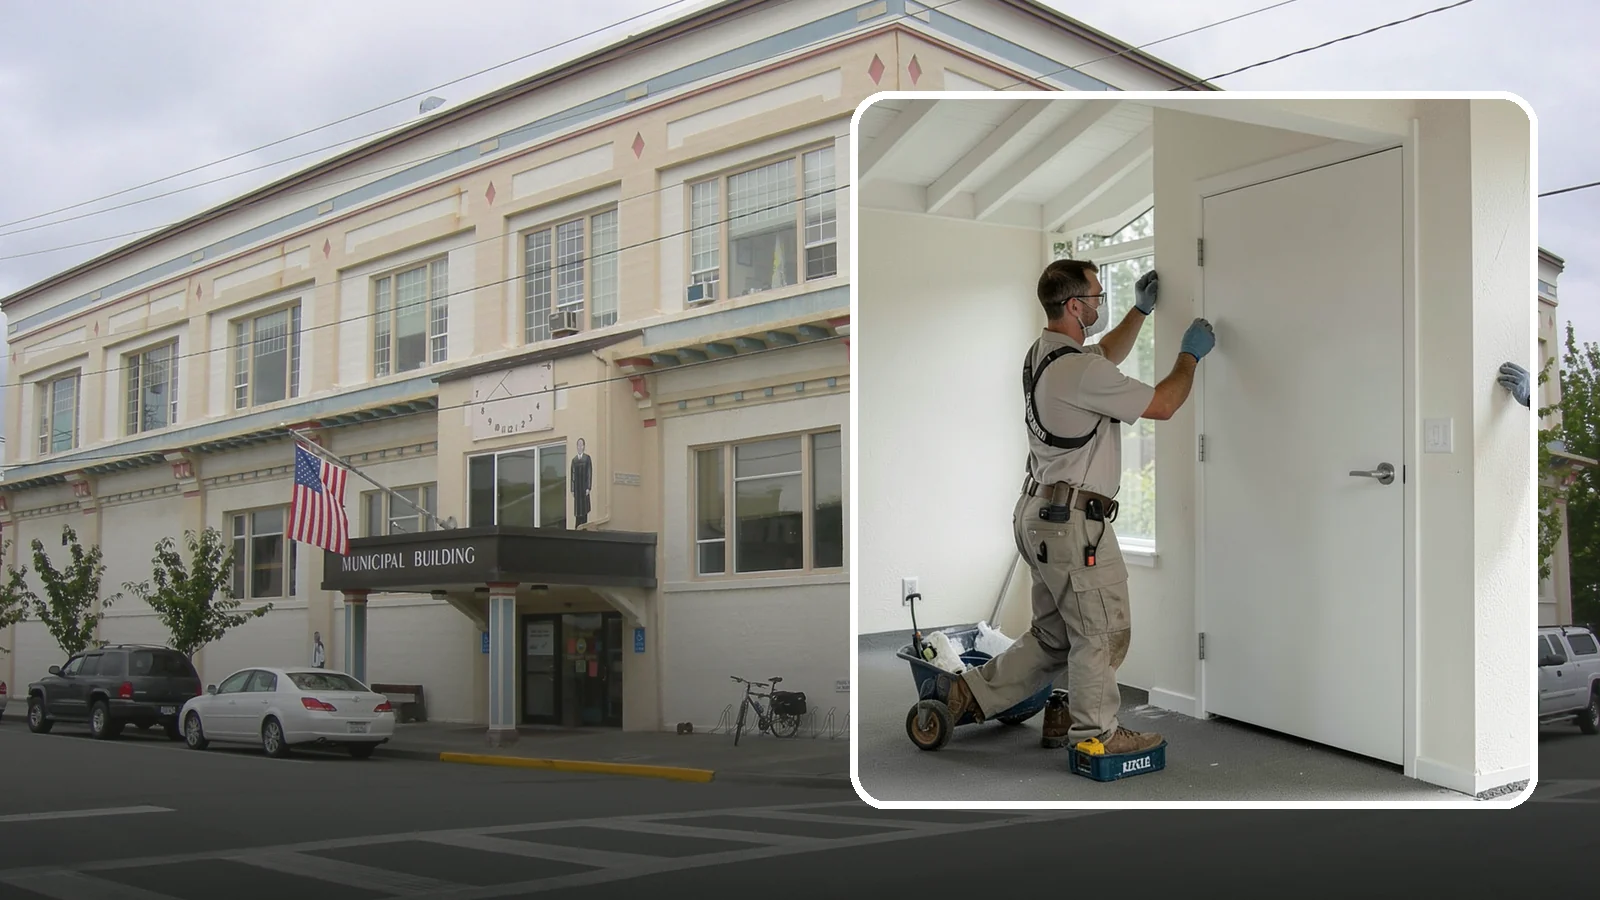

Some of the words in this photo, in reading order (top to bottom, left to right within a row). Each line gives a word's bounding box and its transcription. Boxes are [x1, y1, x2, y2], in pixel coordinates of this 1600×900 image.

[536, 402, 540, 410] 4
[529, 414, 533, 422] 3
[342, 552, 405, 572] MUNICIPAL
[414, 546, 475, 567] BUILDING
